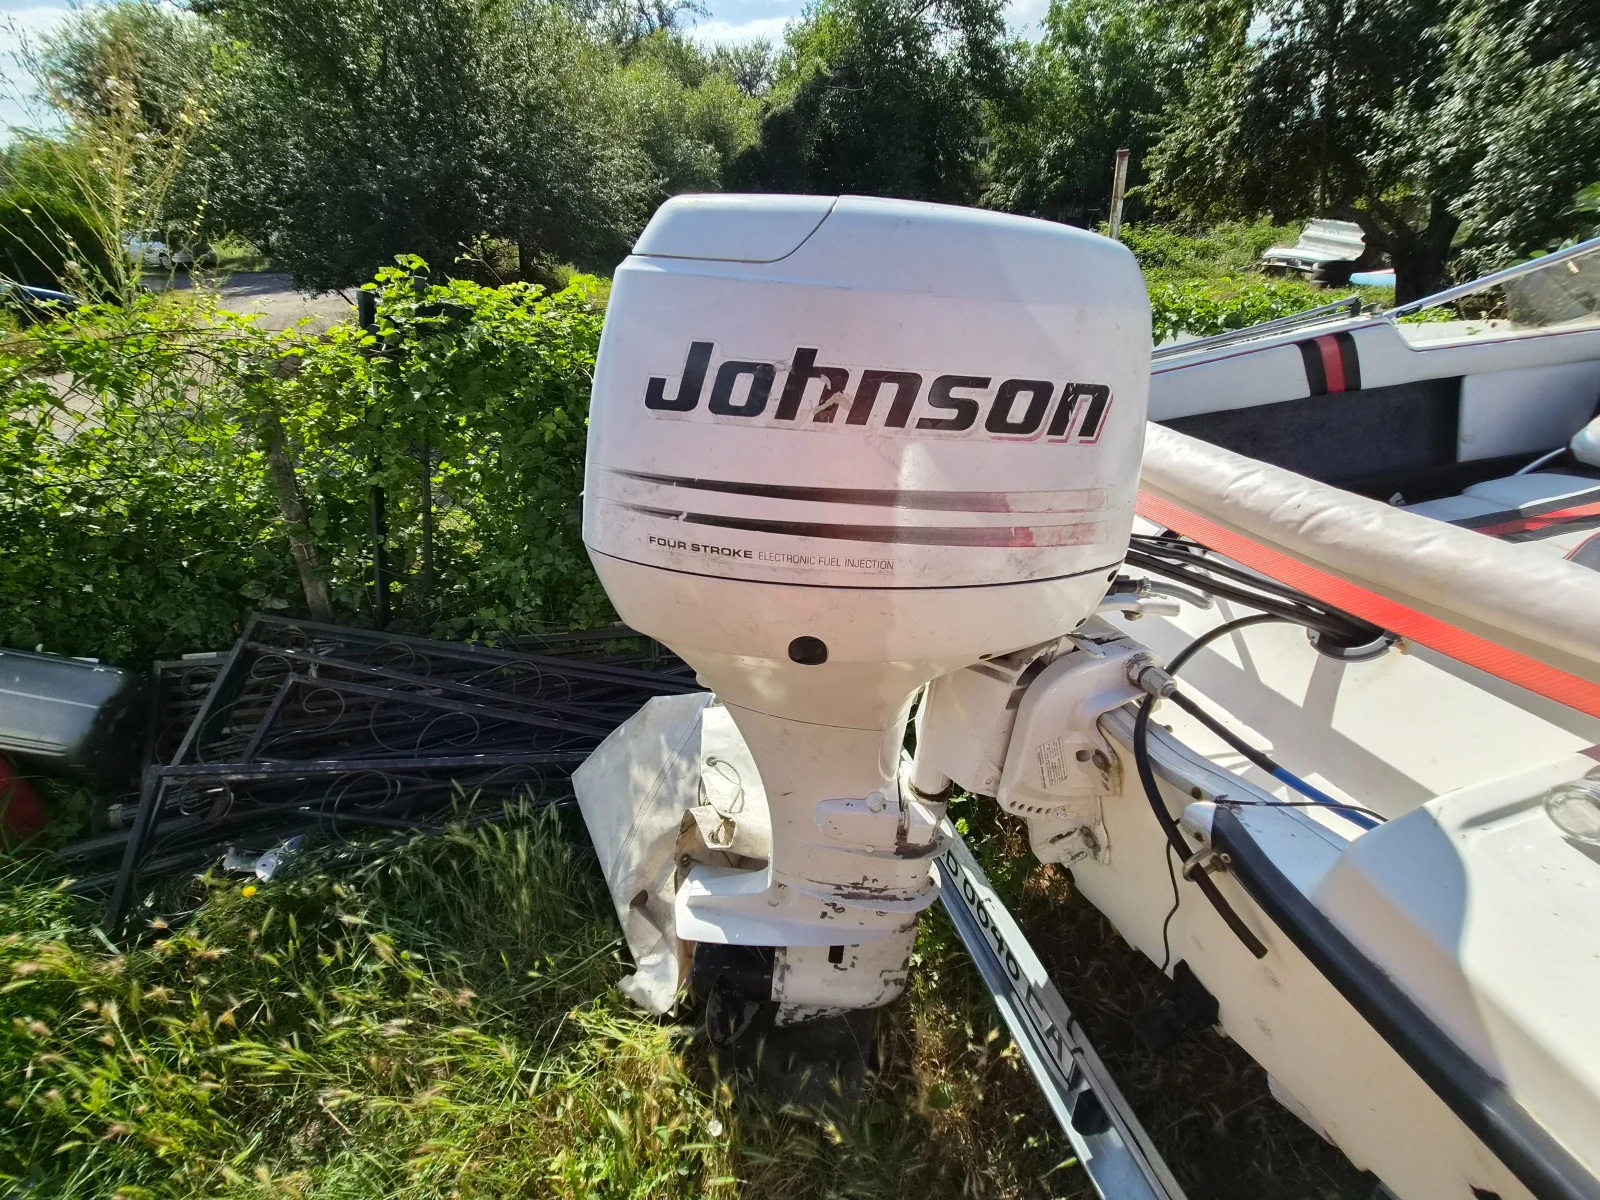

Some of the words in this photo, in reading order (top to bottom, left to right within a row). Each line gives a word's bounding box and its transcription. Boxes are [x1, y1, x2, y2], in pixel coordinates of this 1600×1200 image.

[645, 341, 1111, 440] Johnson
[649, 536, 687, 550] FOUR
[690, 543, 753, 559] STROKE
[758, 551, 816, 565] ELECTRONIC
[818, 556, 841, 567] FUEL
[844, 558, 894, 570] INJECTION
